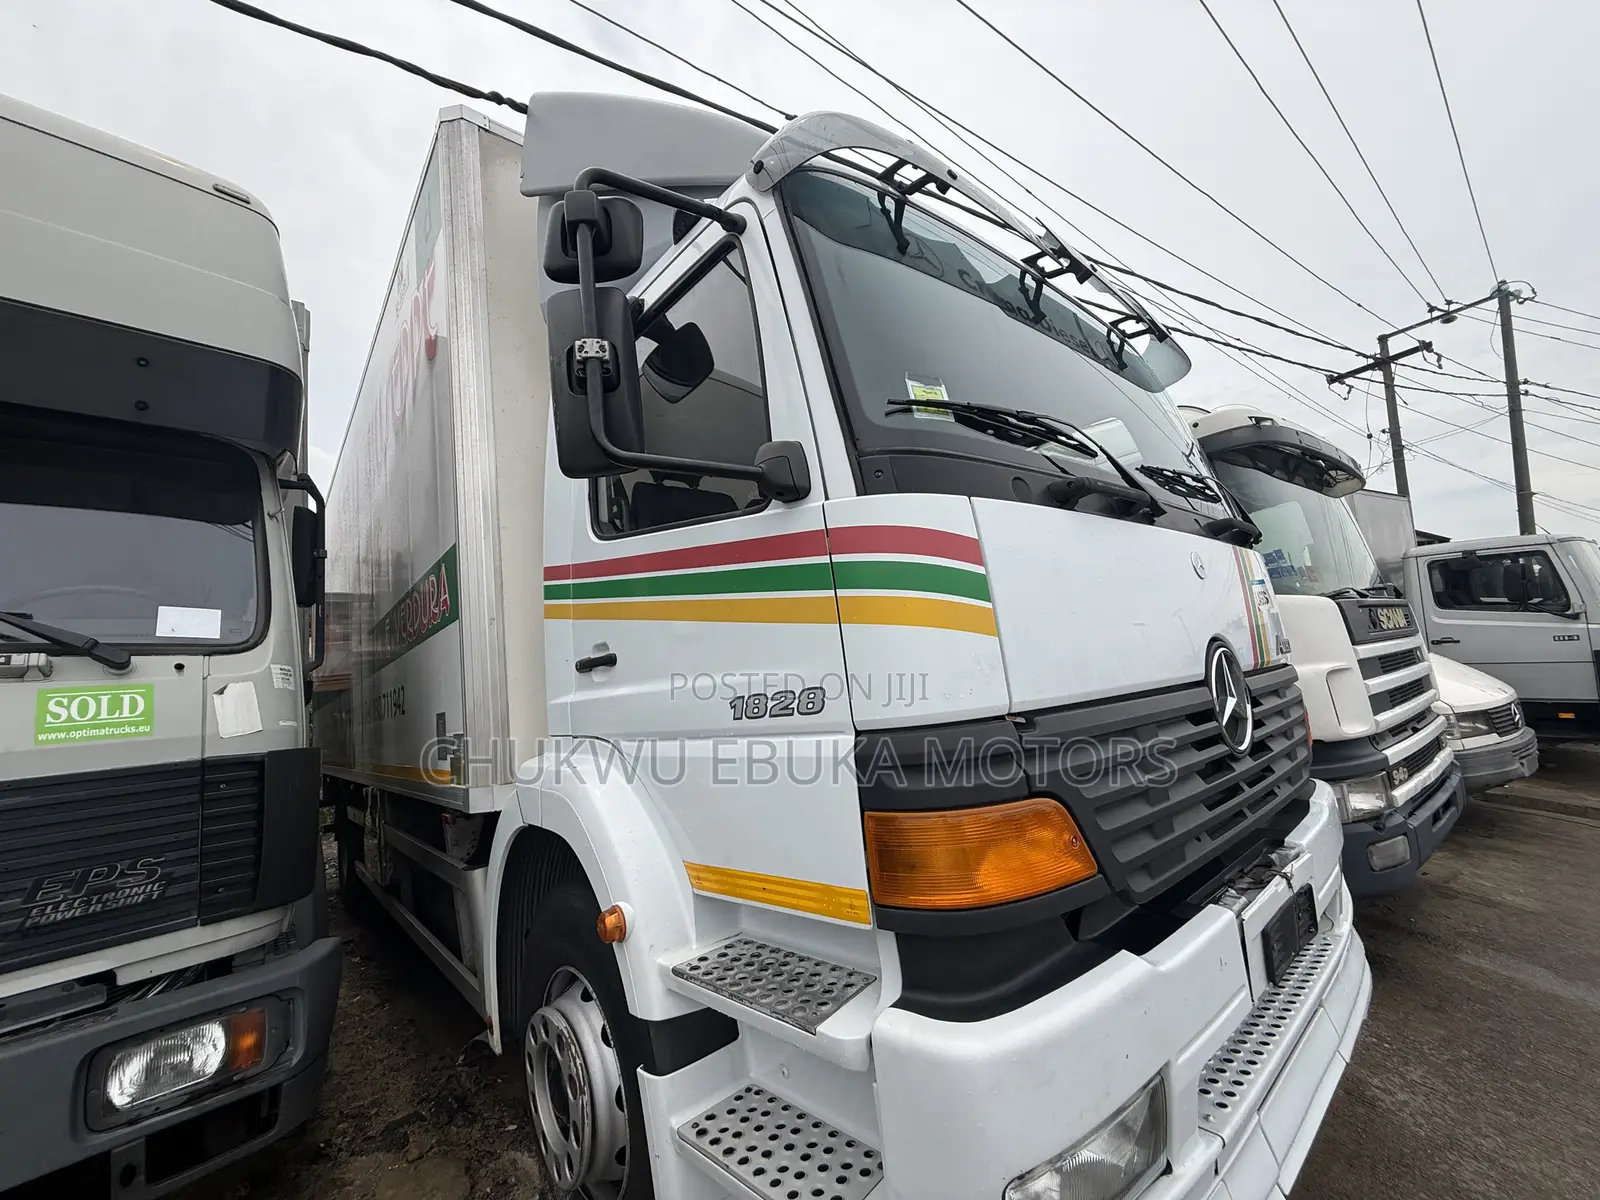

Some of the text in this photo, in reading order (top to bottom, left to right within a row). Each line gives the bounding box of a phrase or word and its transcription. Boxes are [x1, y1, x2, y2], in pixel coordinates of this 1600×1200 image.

[46, 694, 145, 723] SOLD
[729, 686, 826, 721] 1828
[37, 724, 151, 741] www.optimatrucks.eu
[35, 857, 165, 901] EPS
[24, 891, 160, 928] POWERSHIFT
[30, 882, 166, 917] ELECTRONIC
